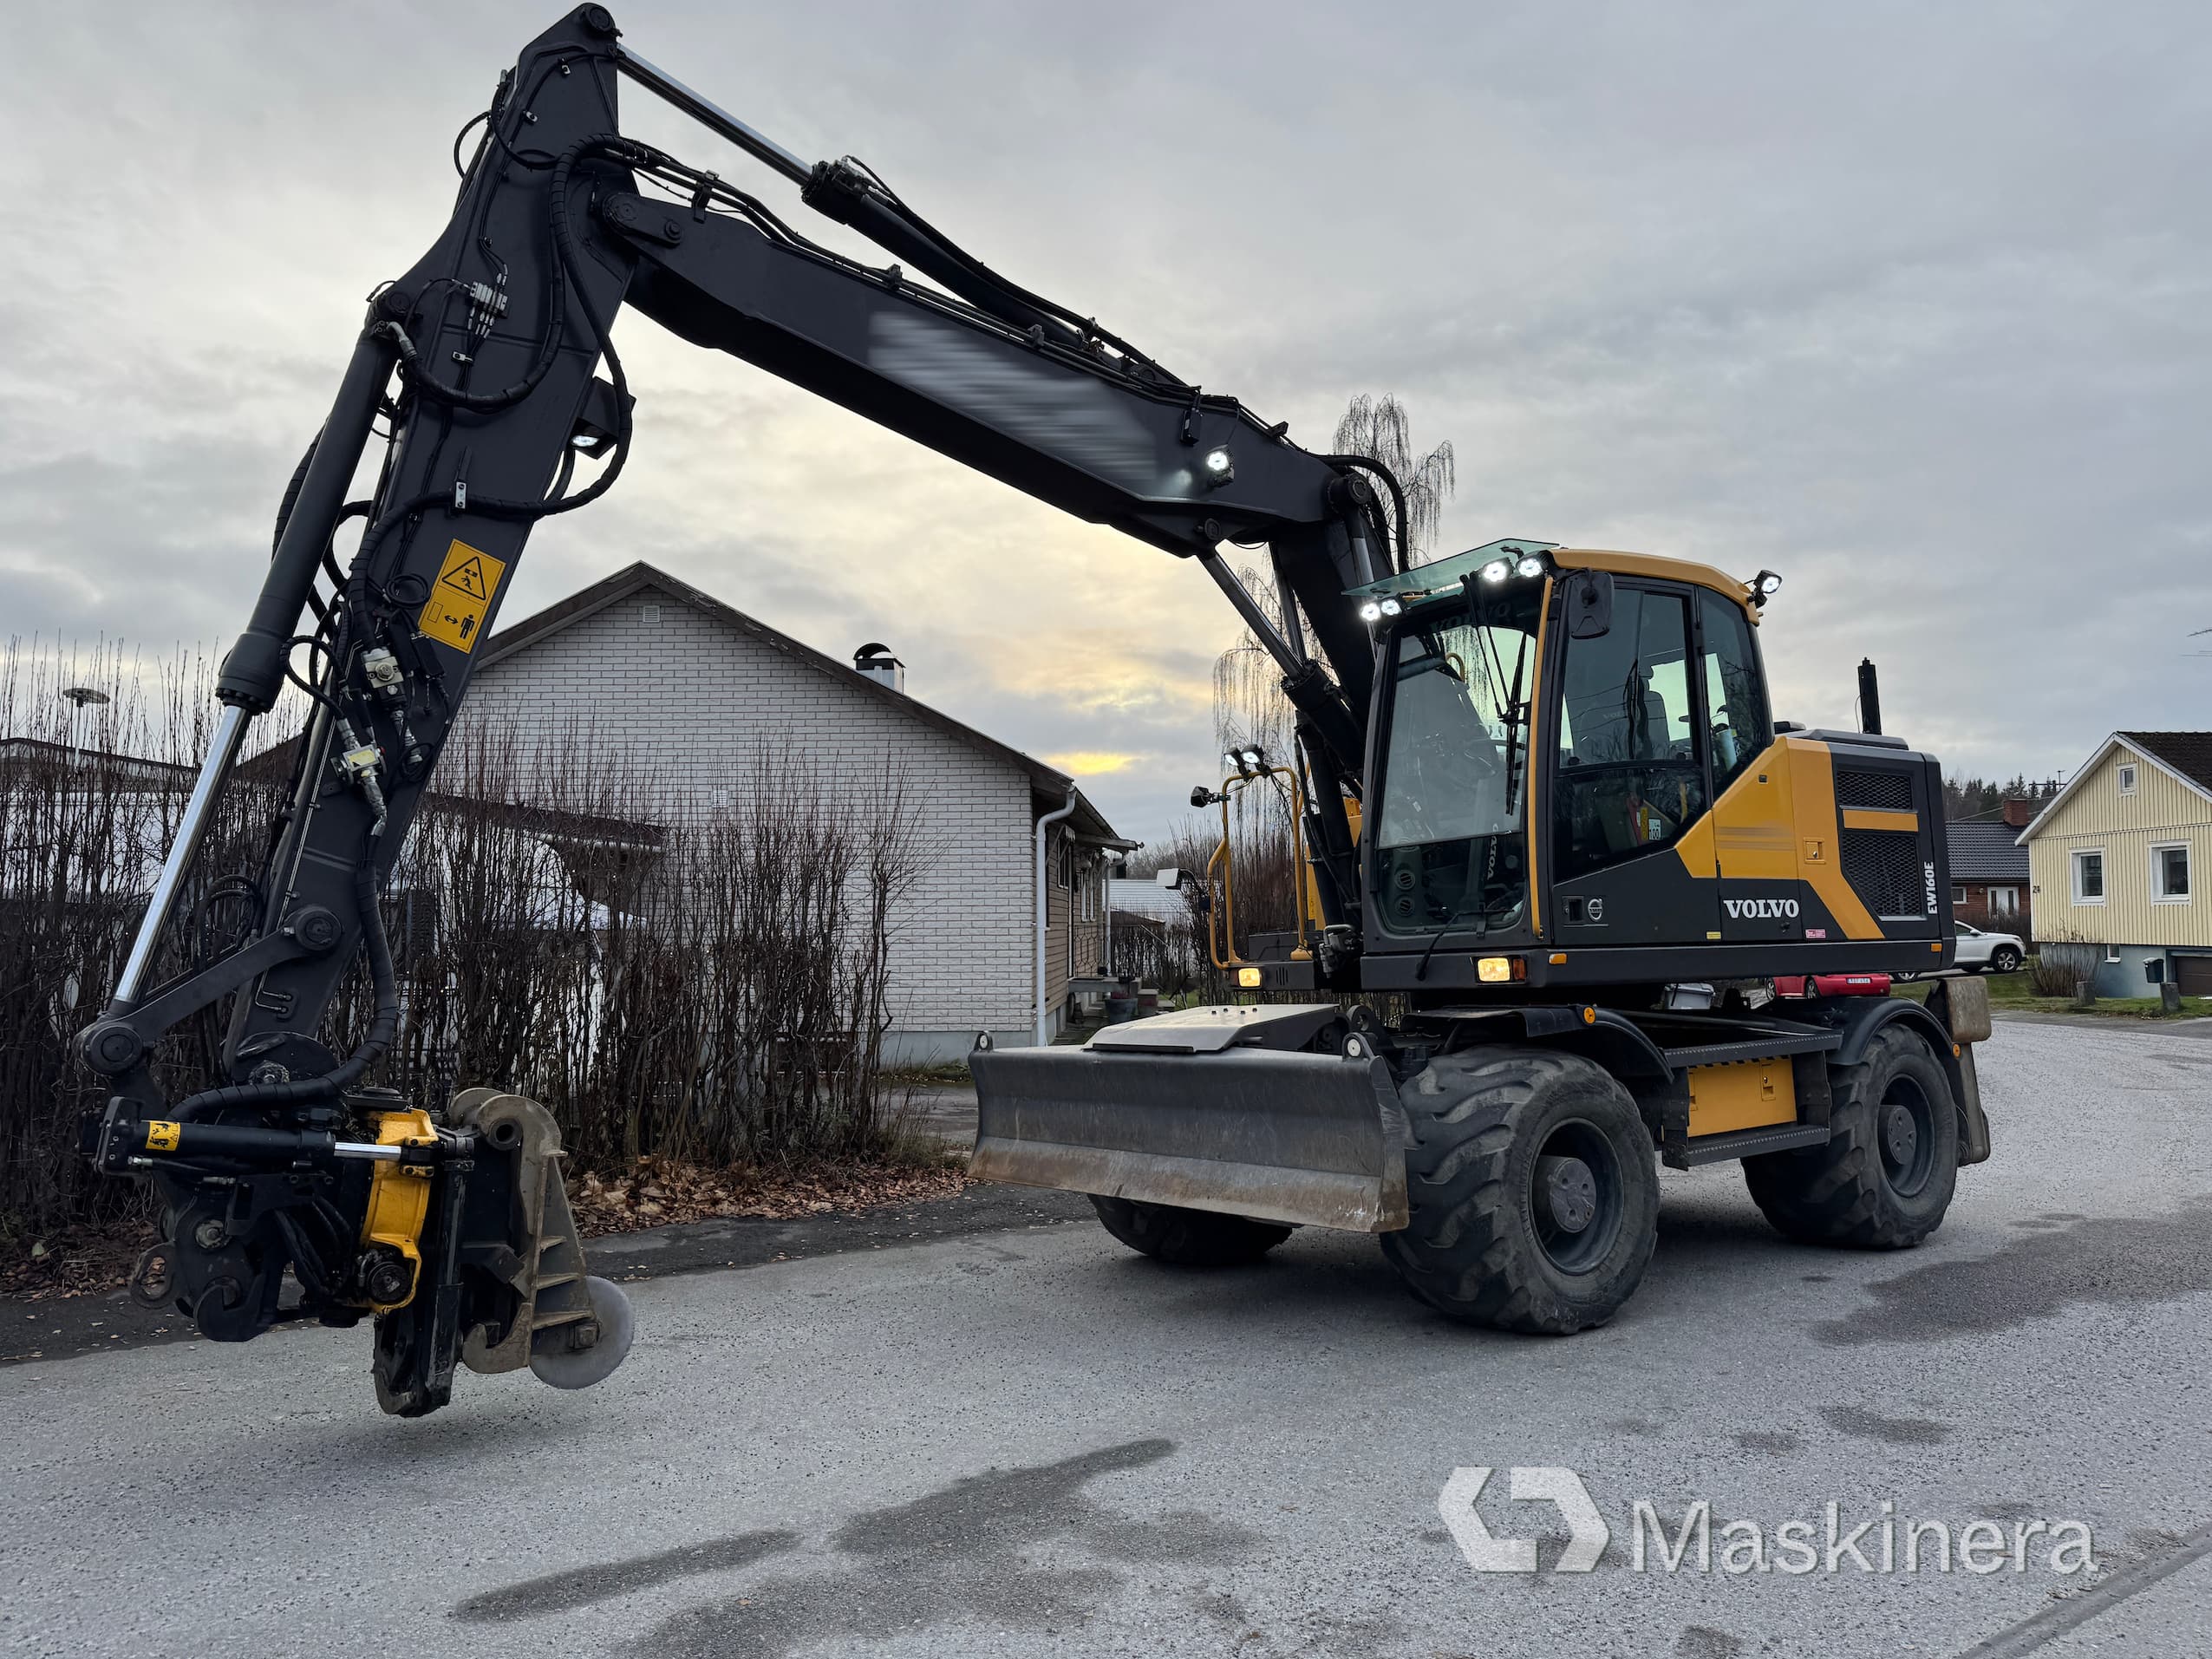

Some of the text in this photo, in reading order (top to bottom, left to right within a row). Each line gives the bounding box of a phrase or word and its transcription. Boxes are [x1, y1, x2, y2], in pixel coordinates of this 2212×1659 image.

[1486, 823, 1498, 880] VOLVO
[1724, 899, 1799, 918] VOLVO
[1924, 861, 1938, 915] EW160E
